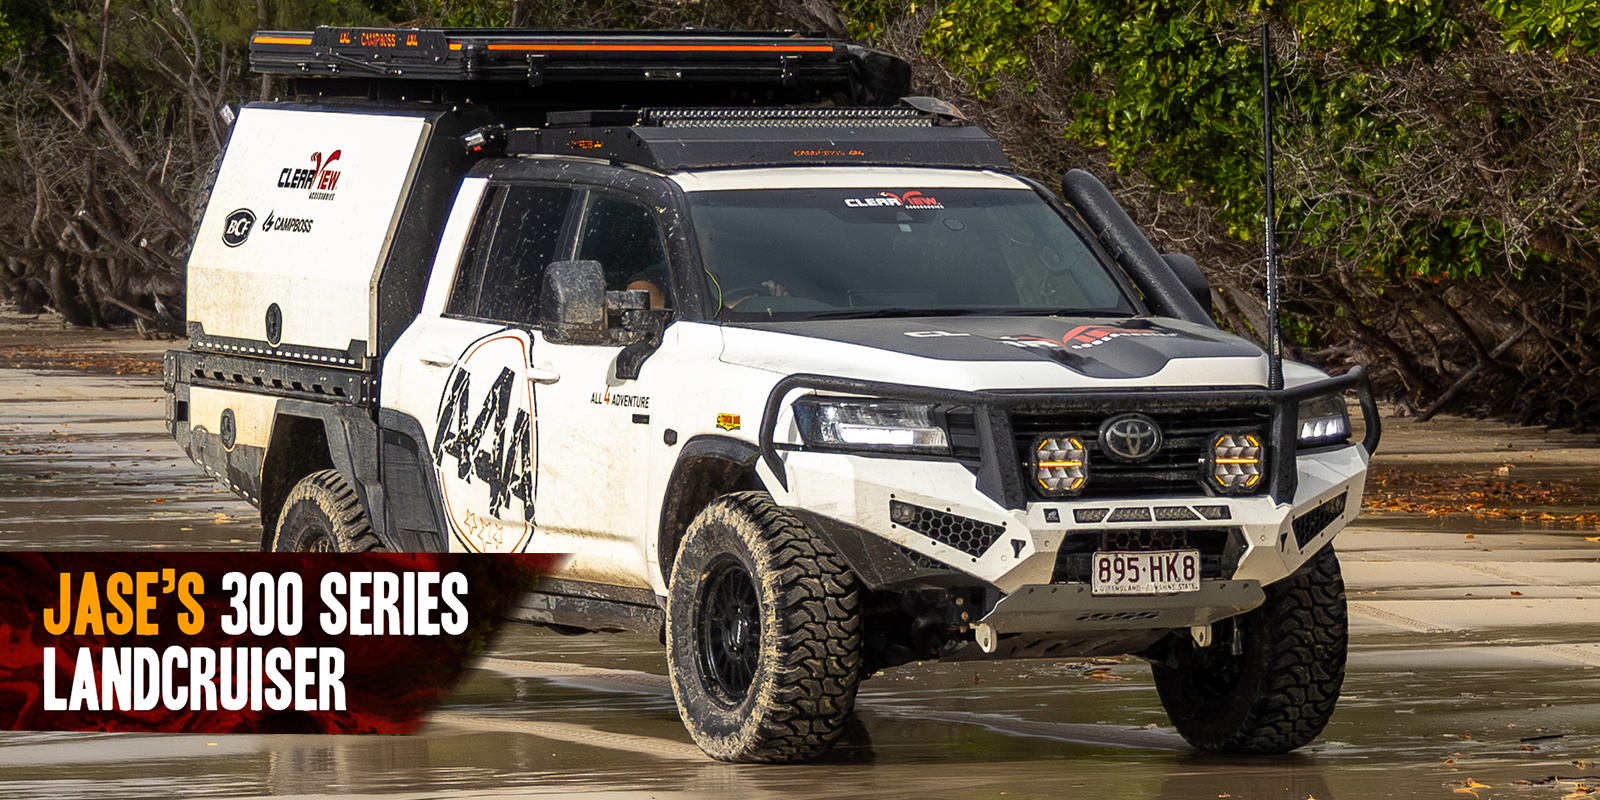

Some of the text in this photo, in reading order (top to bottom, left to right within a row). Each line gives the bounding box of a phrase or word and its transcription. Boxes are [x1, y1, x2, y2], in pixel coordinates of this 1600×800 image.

[277, 149, 342, 191] CLEARVIEW
[844, 190, 938, 207] CLEARVIEW
[226, 217, 252, 237] BCF
[274, 216, 314, 234] CAMPBOSS
[590, 386, 650, 409] ALL 4 ADVENTURE
[1099, 584, 1141, 593] QEENSLAND
